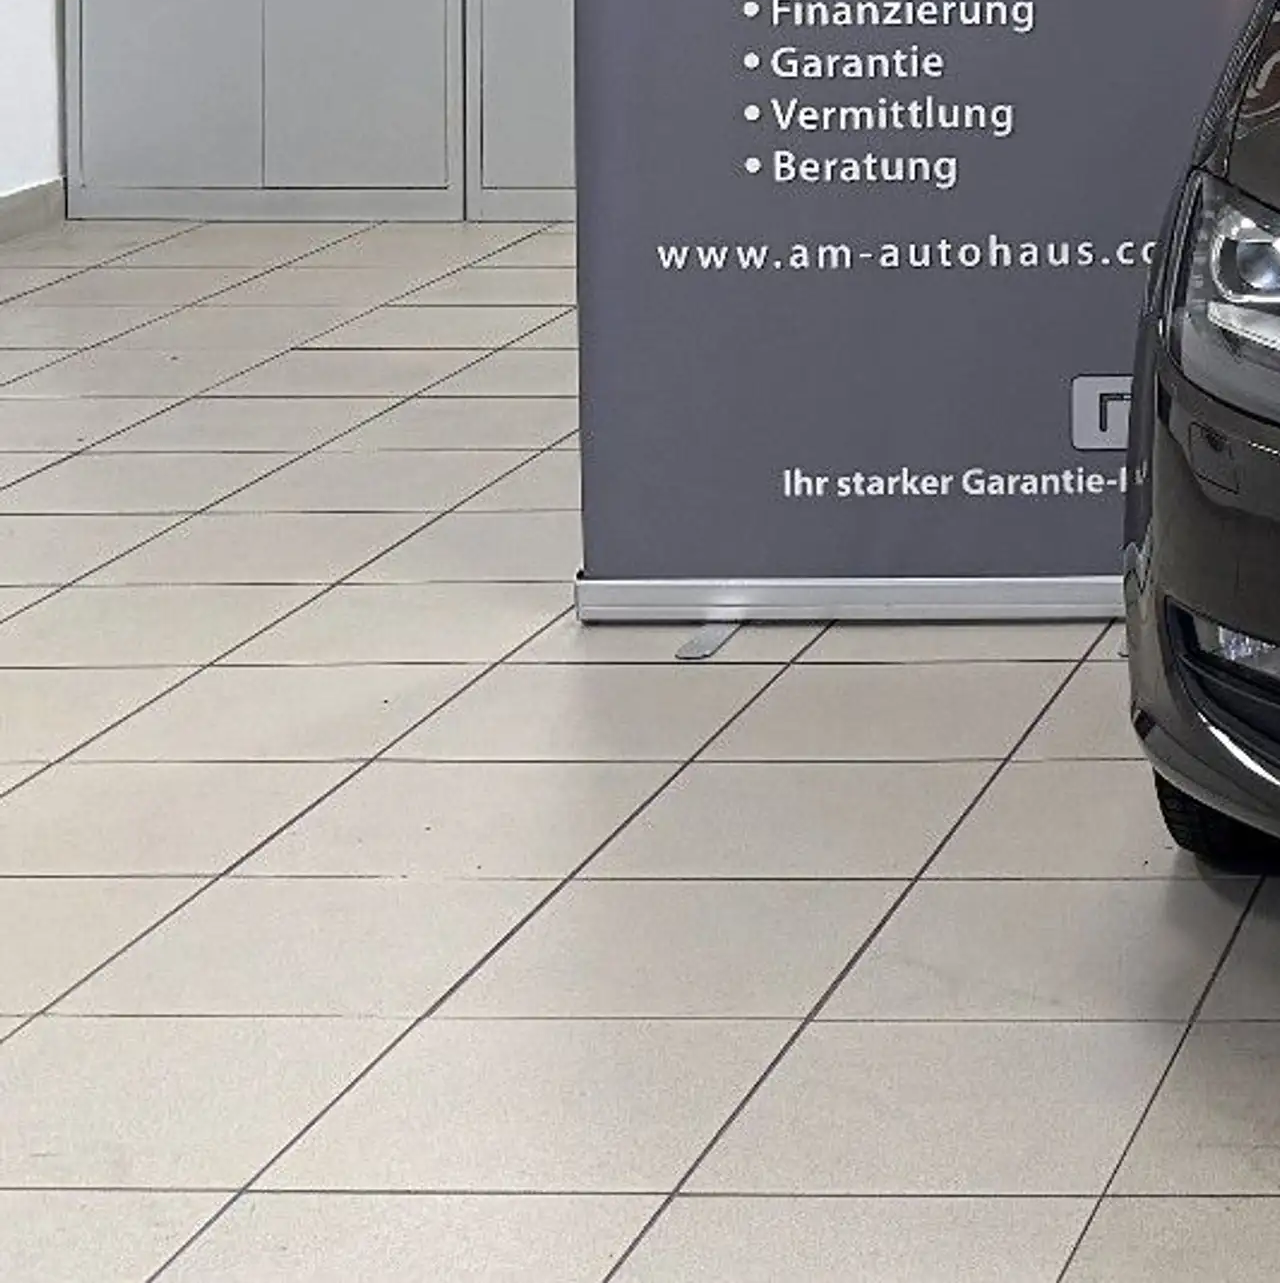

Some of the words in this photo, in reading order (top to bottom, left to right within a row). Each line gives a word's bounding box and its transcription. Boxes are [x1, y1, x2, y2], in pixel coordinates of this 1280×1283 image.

[769, 44, 945, 79] Garantie
[770, 95, 1014, 137] Vermittlung
[772, 149, 958, 189] Beratung
[783, 467, 830, 498] Ihr
[836, 466, 954, 498] starker
